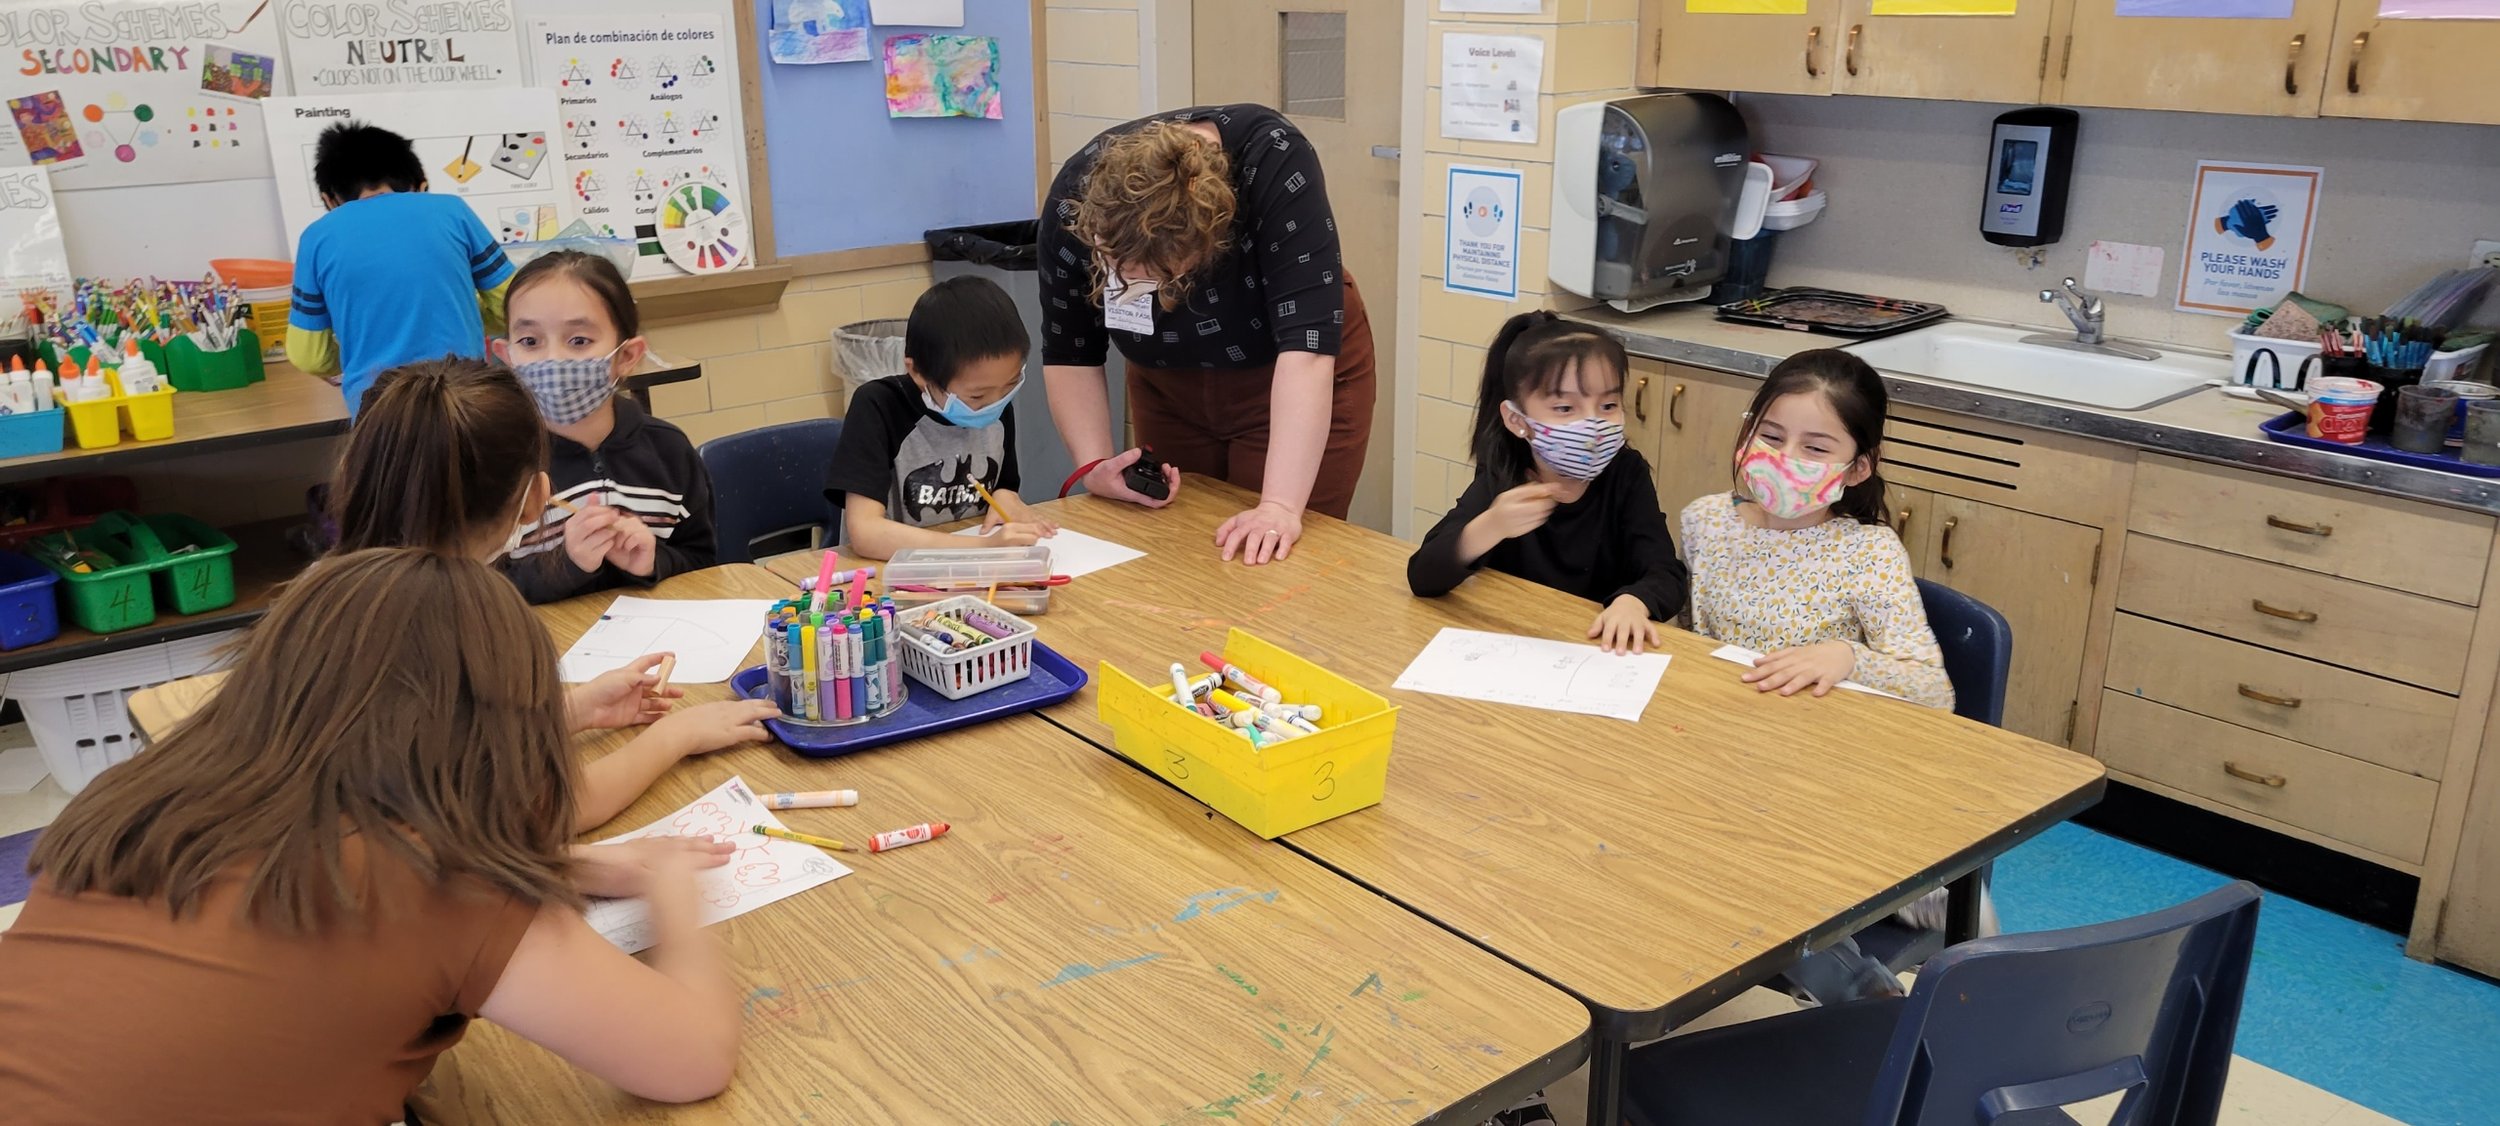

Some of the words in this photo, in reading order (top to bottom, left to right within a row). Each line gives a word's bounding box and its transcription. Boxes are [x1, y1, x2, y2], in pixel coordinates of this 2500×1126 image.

[79, 1, 229, 45] SCHEMES
[284, 0, 388, 39] COLOR
[386, 0, 512, 36] SCHEMES
[545, 32, 571, 45] Plan
[573, 31, 588, 44] de
[590, 29, 659, 43] combinación
[661, 29, 675, 41] de
[676, 28, 715, 40] colores
[19, 45, 190, 77] SECONDARY
[346, 37, 466, 67] NEUTRAL
[1469, 47, 1491, 57] Voice
[1492, 48, 1517, 58] Levels
[402, 65, 429, 84] THE
[459, 63, 497, 81] WHEEL
[560, 97, 597, 106] Primarios
[294, 107, 351, 119] Painting
[564, 152, 609, 161] Secundarios
[642, 147, 703, 158] Complementarios
[582, 206, 610, 215] Cálidos
[2201, 252, 2247, 266] PLEASE
[2251, 256, 2287, 270] WASH
[2204, 262, 2235, 275] YOUR
[2238, 266, 2280, 280] HANDS
[1108, 307, 1133, 317] VISITOR
[191, 564, 212, 600] 4
[110, 584, 136, 622] 4
[1165, 748, 1190, 781] 3
[1311, 760, 1336, 802] 3
